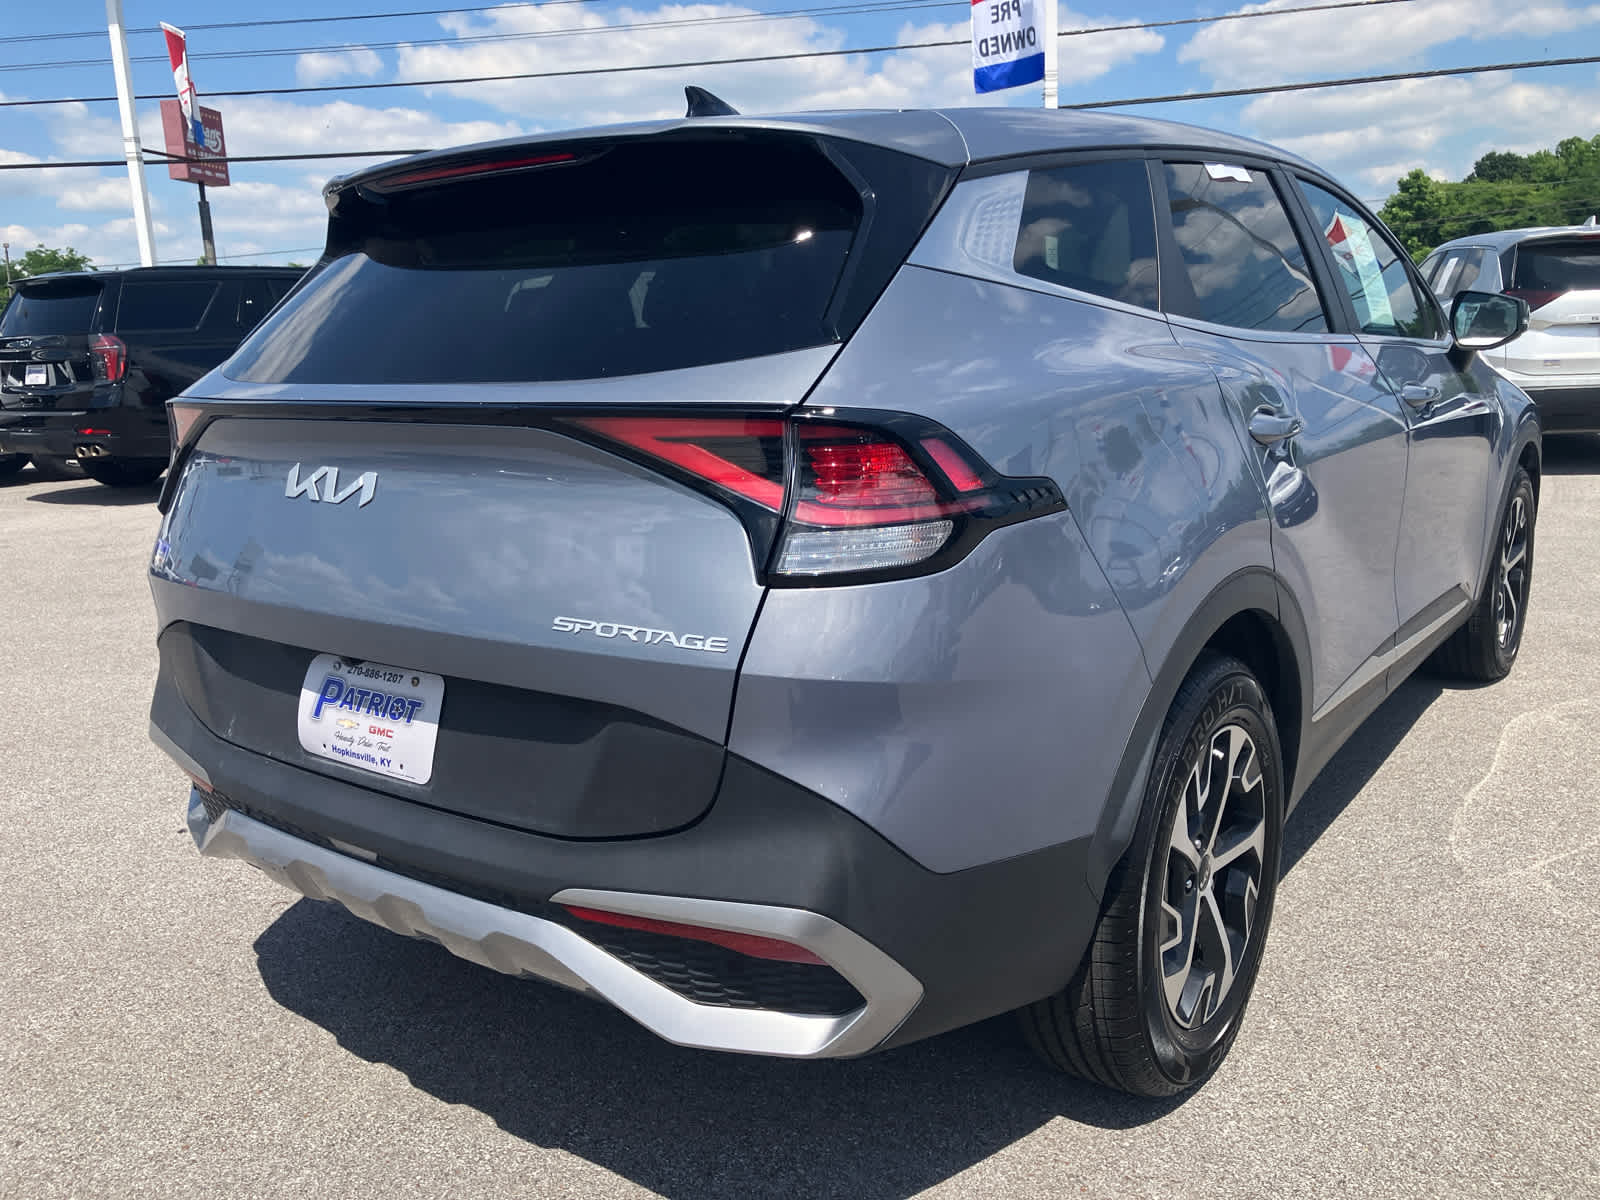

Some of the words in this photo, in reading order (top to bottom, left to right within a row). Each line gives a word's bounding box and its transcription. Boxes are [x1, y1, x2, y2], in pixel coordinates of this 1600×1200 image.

[285, 462, 378, 509] KIA
[551, 615, 729, 653] SPORTAGE
[312, 674, 424, 724] PATRIOT
[368, 725, 394, 739] GMC
[331, 744, 378, 767] Hopkinsville,
[380, 757, 392, 768] KY
